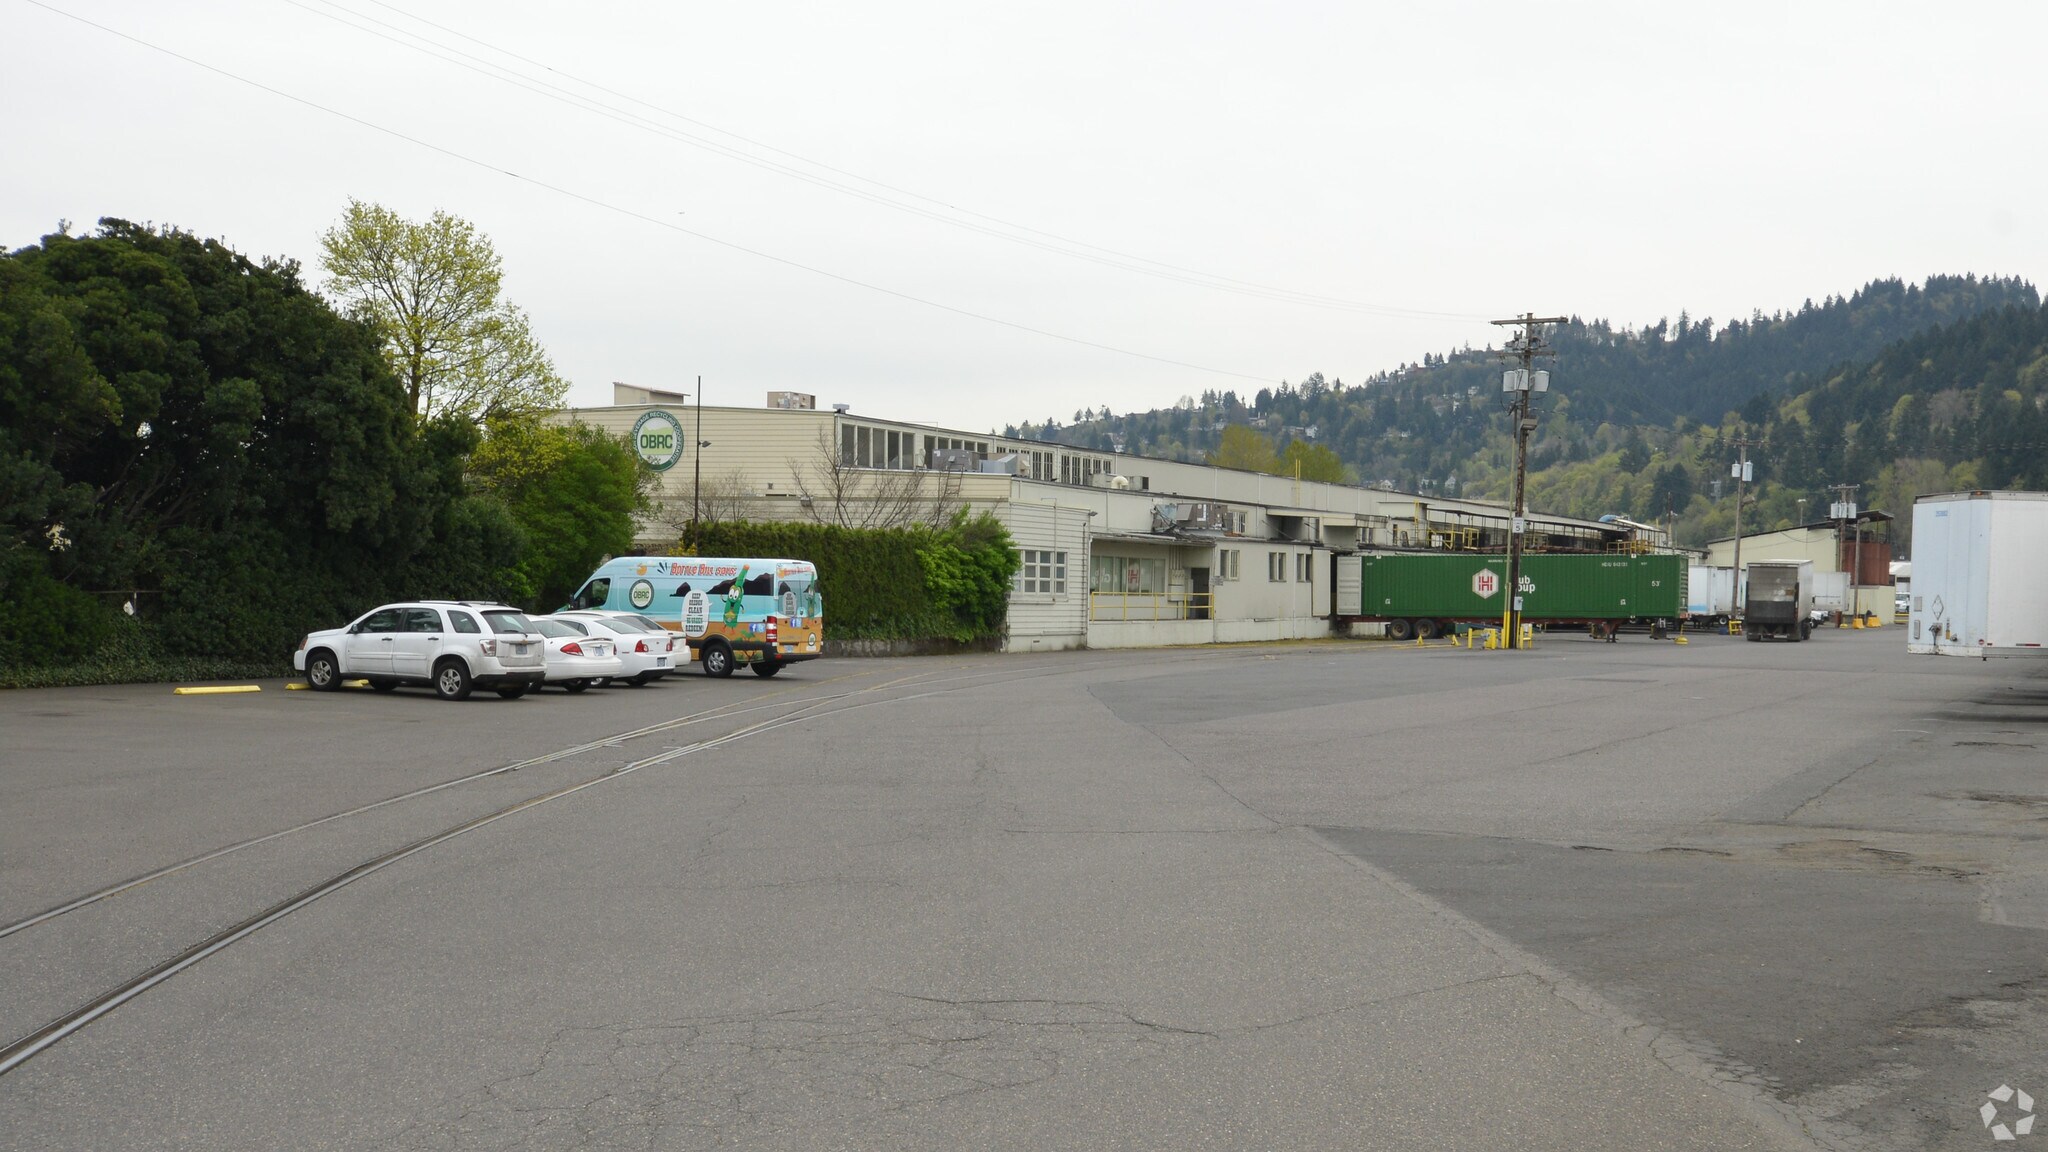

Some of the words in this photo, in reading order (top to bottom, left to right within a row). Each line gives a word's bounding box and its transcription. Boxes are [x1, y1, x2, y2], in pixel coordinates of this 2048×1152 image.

[649, 411, 676, 426] RECYCLING
[640, 434, 673, 449] OBRC
[633, 590, 650, 599] OBRC
[688, 606, 703, 614] CLEAN
